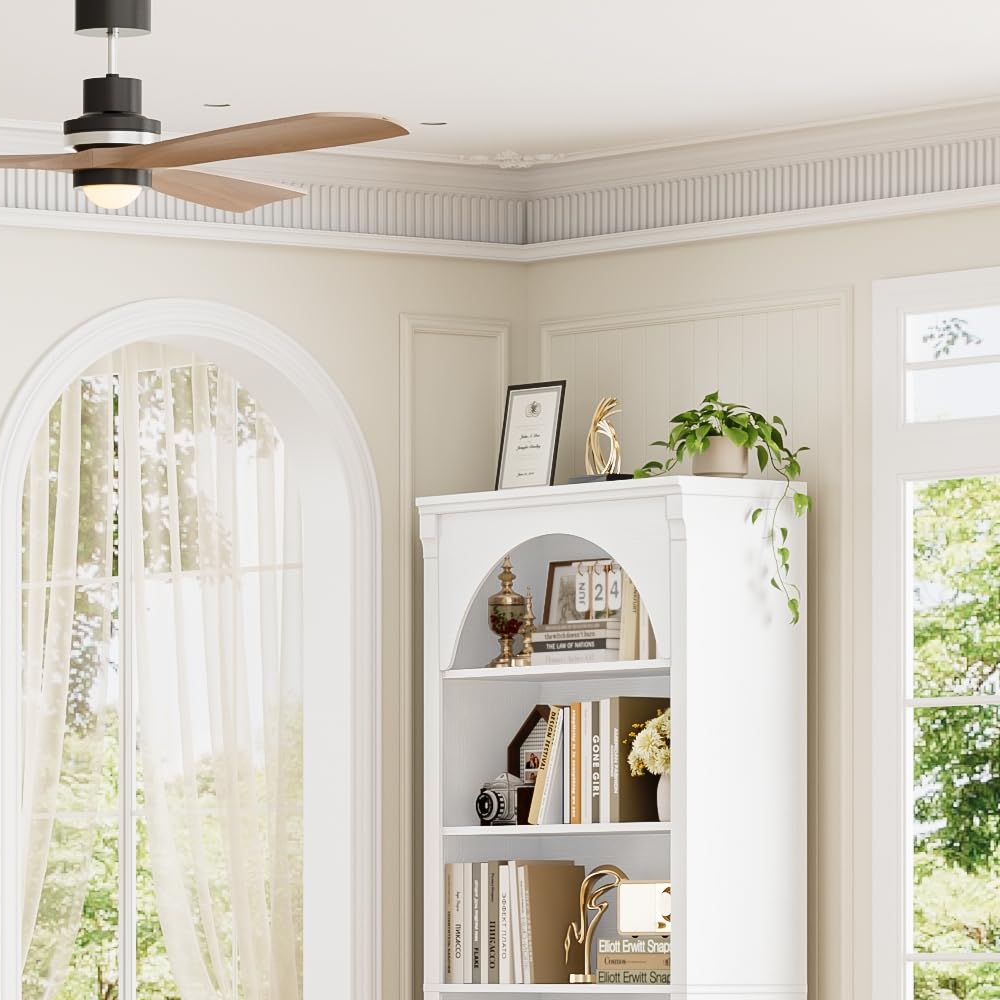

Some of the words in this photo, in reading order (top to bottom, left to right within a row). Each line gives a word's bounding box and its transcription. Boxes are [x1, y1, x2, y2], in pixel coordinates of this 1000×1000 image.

[595, 584, 604, 600] 2
[610, 580, 620, 598] 4
[546, 712, 556, 738] DESIGN
[540, 740, 551, 770] FESTIVAL
[599, 939, 621, 953] Elliott
[623, 939, 646, 953] Erwitt
[647, 939, 670, 954] Snap
[598, 971, 621, 983] Elliott
[623, 971, 647, 983] Erwitt
[650, 971, 670, 984] Snap
